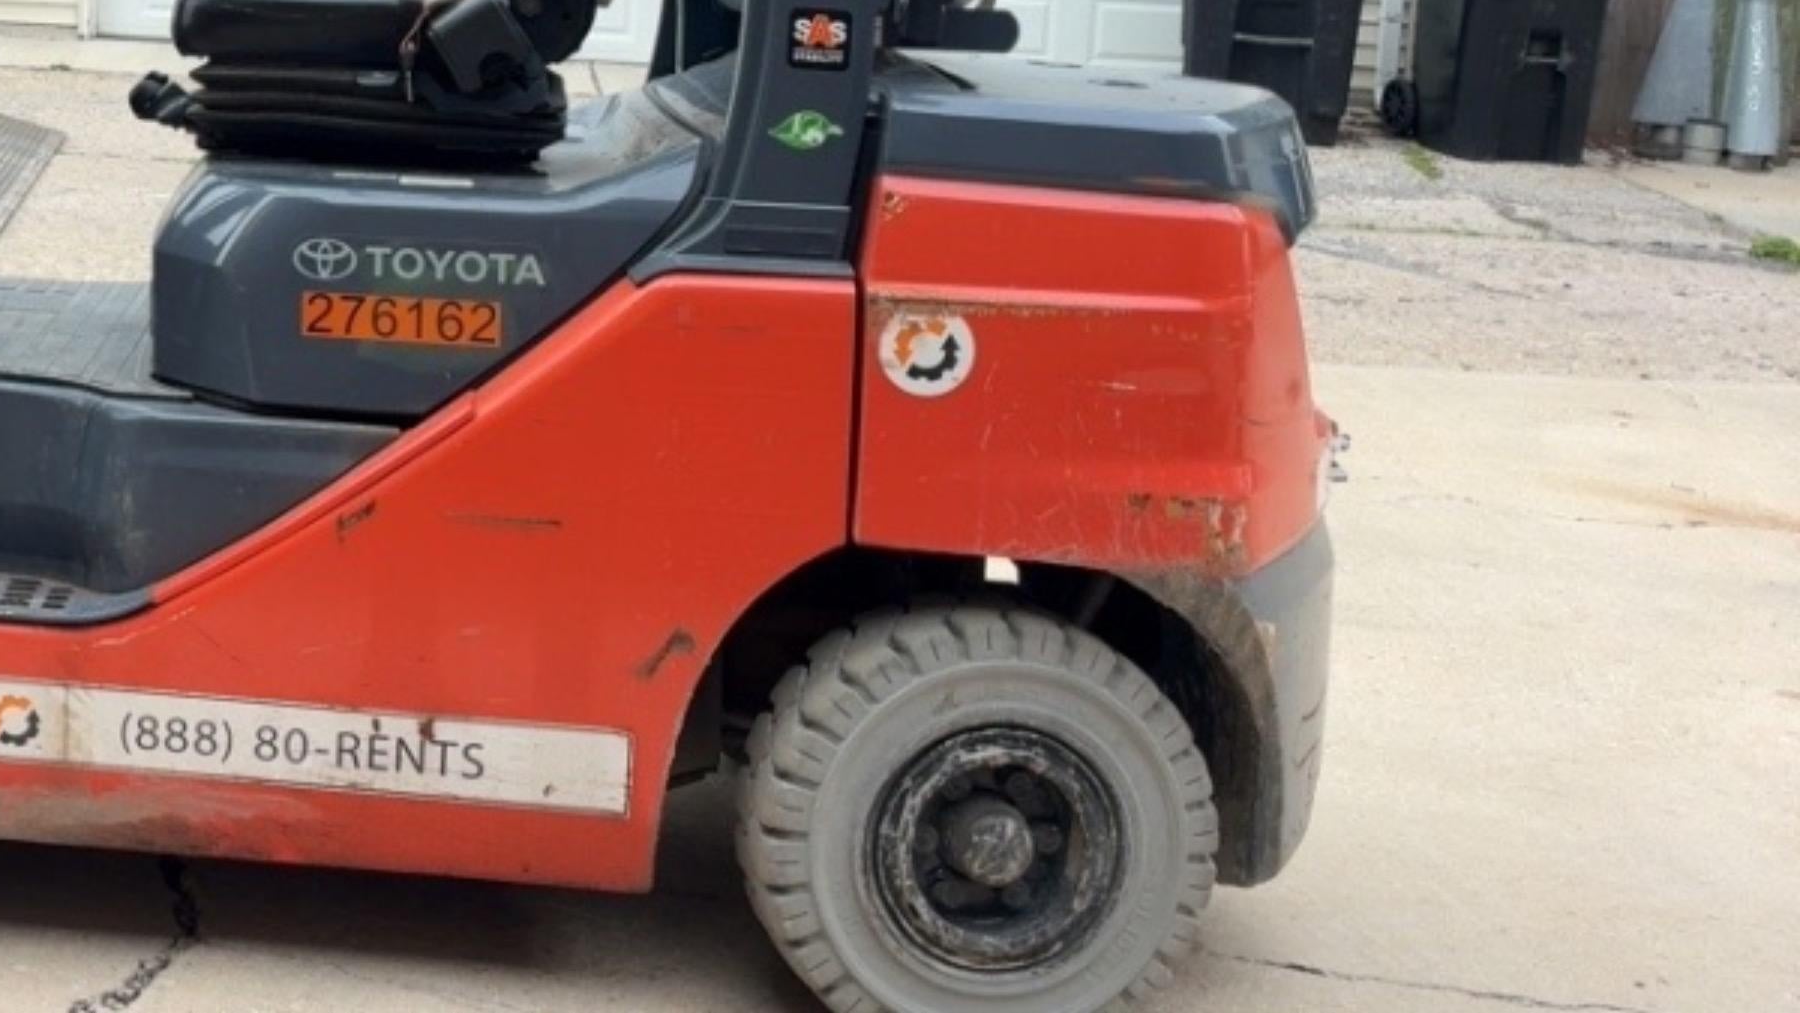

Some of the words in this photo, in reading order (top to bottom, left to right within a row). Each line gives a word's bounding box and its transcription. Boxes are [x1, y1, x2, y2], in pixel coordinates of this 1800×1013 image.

[365, 245, 546, 286] TOYOTA
[305, 292, 497, 343] 276162
[118, 711, 235, 763] (888)
[253, 724, 486, 780] 80-RENTS
